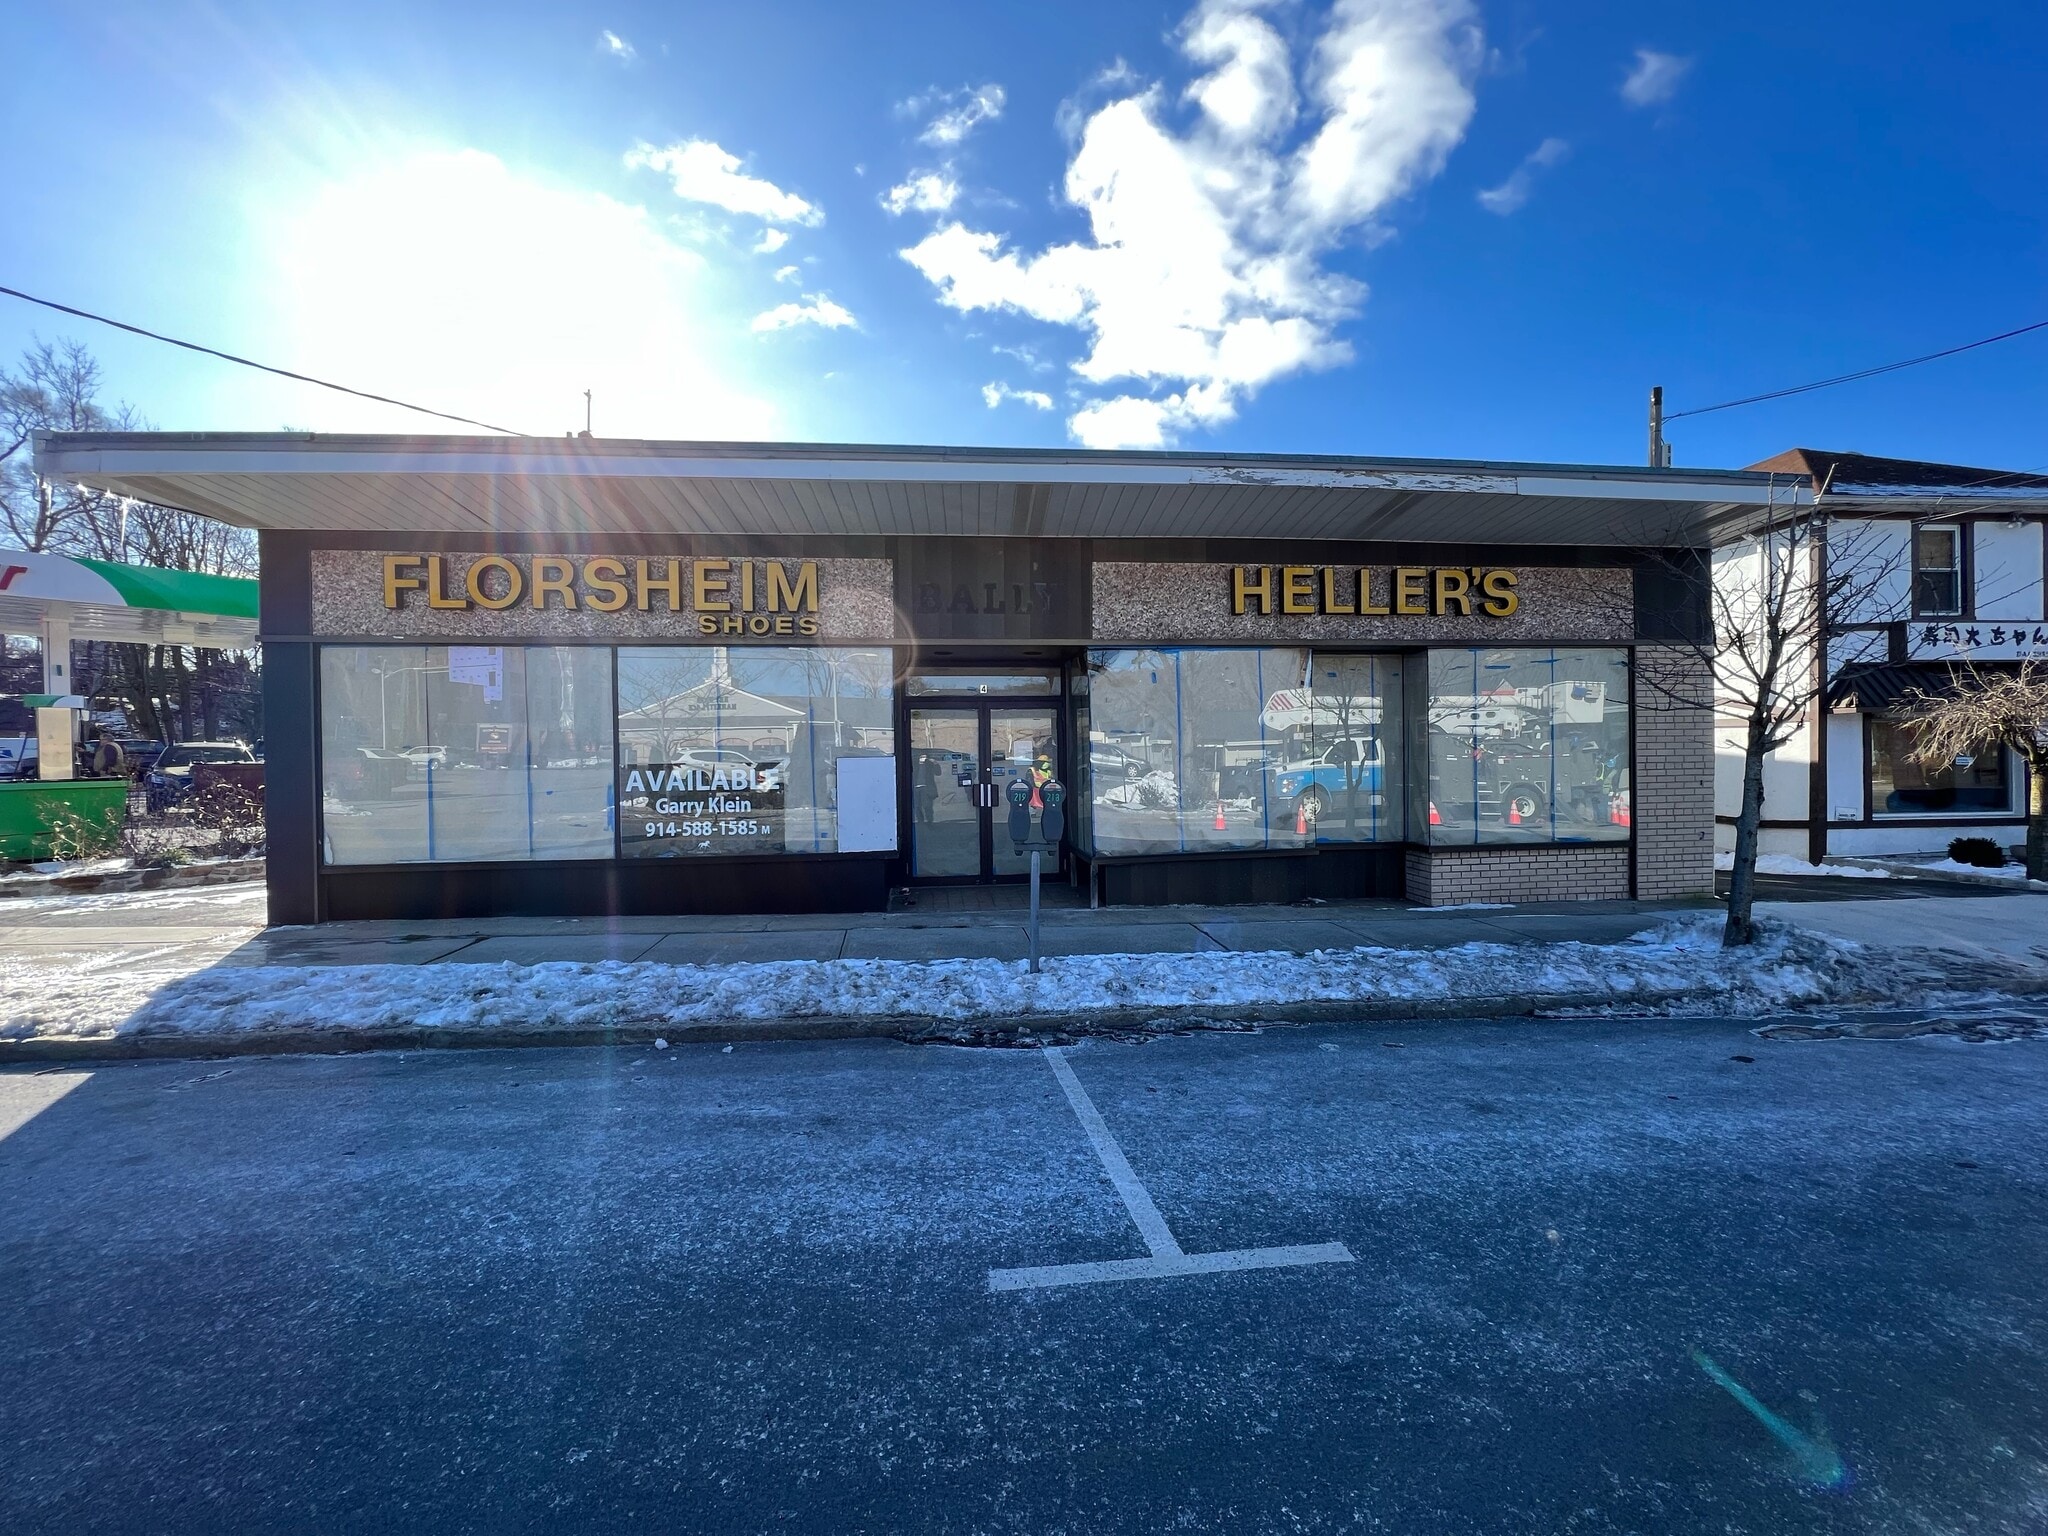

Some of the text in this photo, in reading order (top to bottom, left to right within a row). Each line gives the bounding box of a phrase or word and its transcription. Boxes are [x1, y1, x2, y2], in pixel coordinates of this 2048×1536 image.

[384, 556, 818, 613] FLORSHEIM
[1234, 567, 1519, 617] HELLER'S
[699, 615, 819, 635] SHOES
[625, 768, 780, 792] AVAILABLE
[655, 795, 752, 817] Garry Klein
[645, 820, 771, 837] 914-588-1585 M
